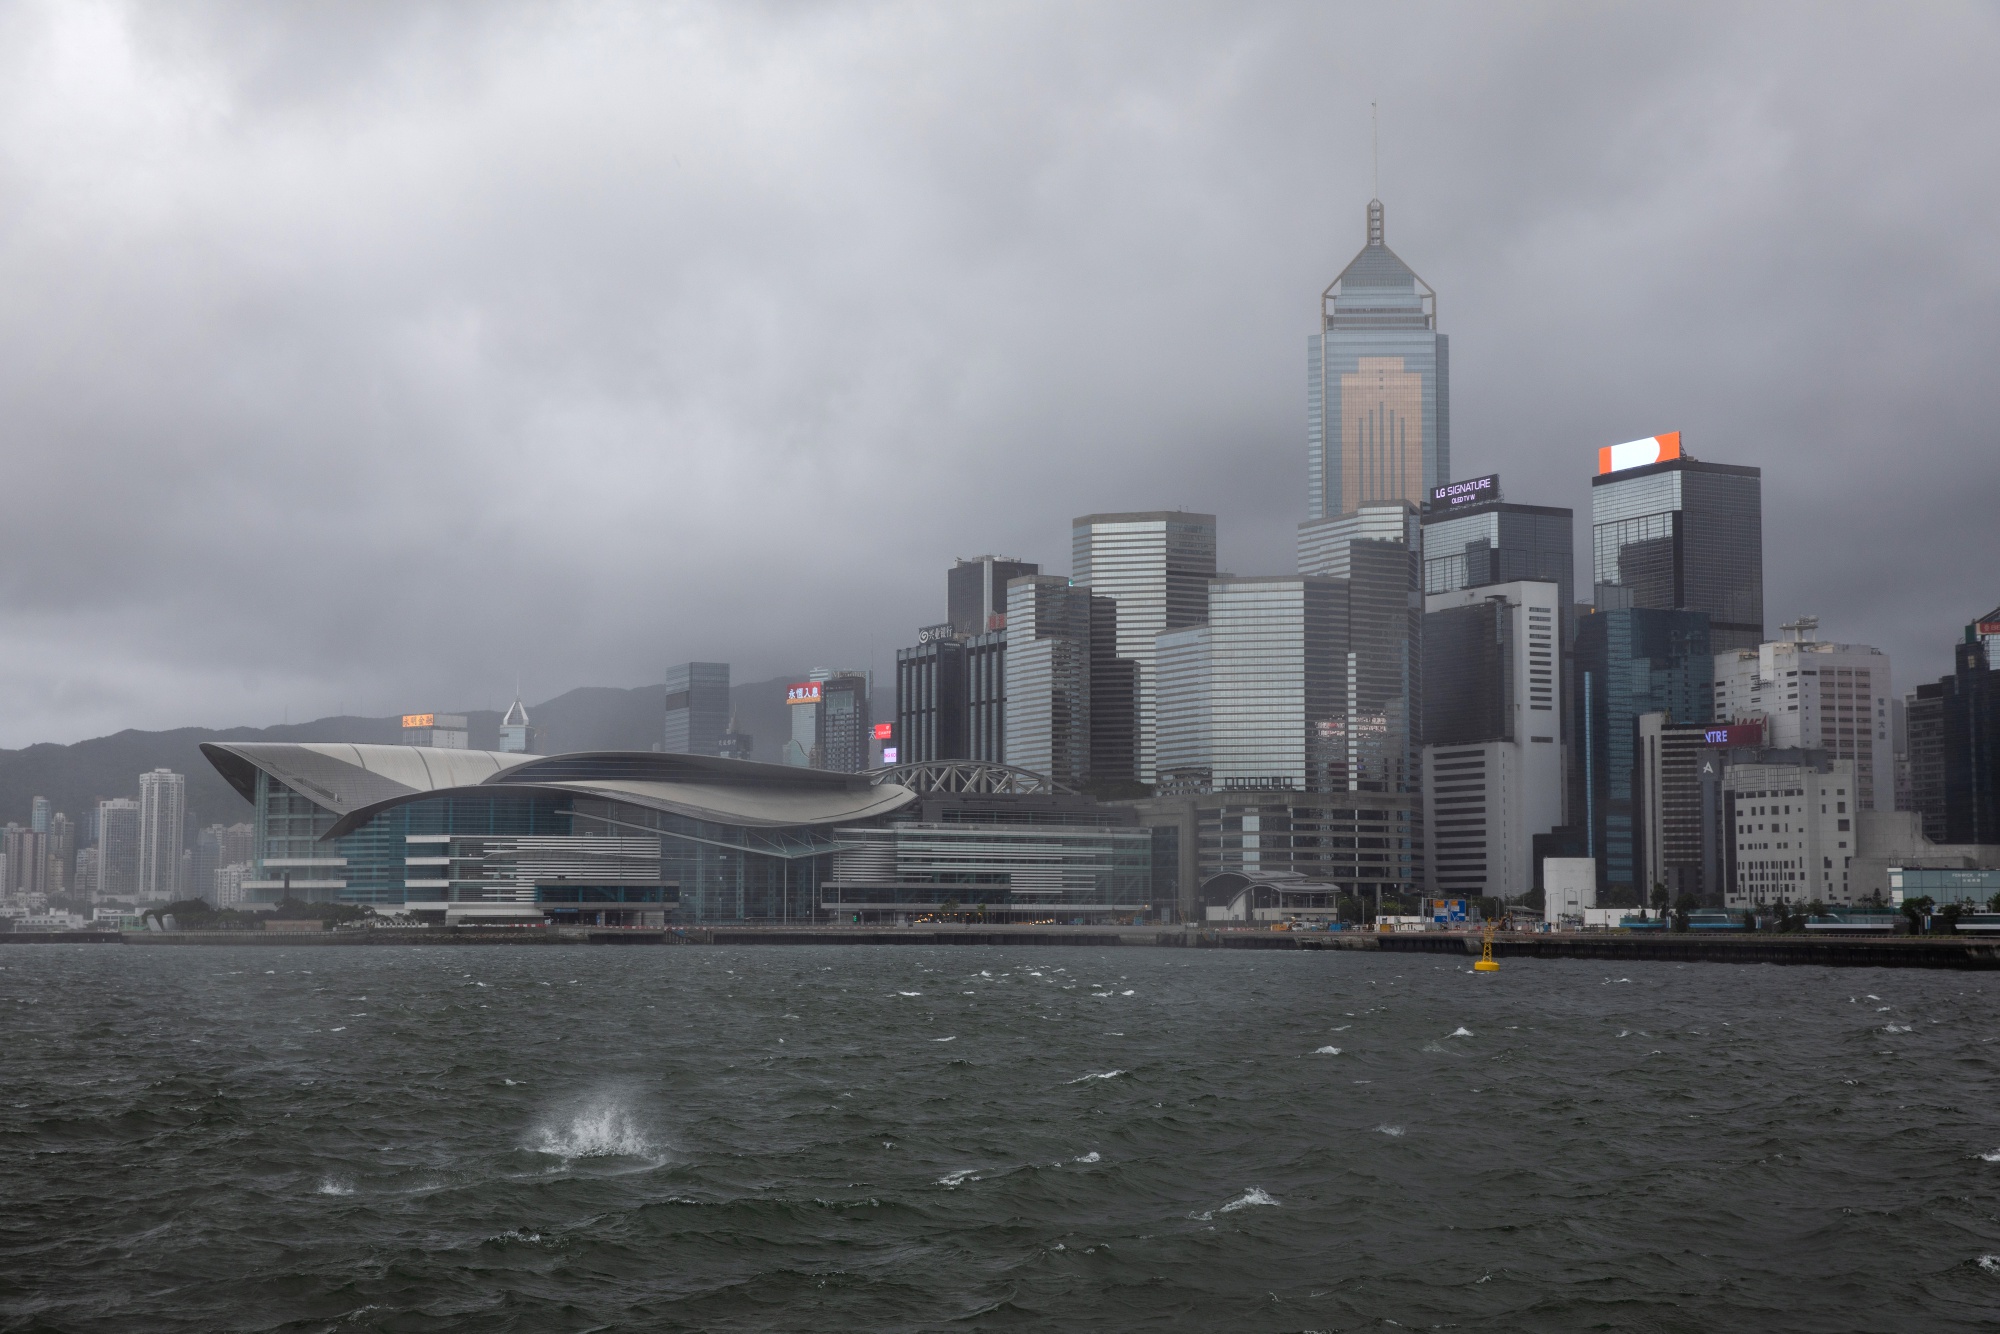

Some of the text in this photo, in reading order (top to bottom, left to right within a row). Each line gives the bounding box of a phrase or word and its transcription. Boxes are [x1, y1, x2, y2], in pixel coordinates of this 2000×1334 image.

[1436, 478, 1490, 498] LG SIGNATURE
[1452, 496, 1463, 504] OLED
